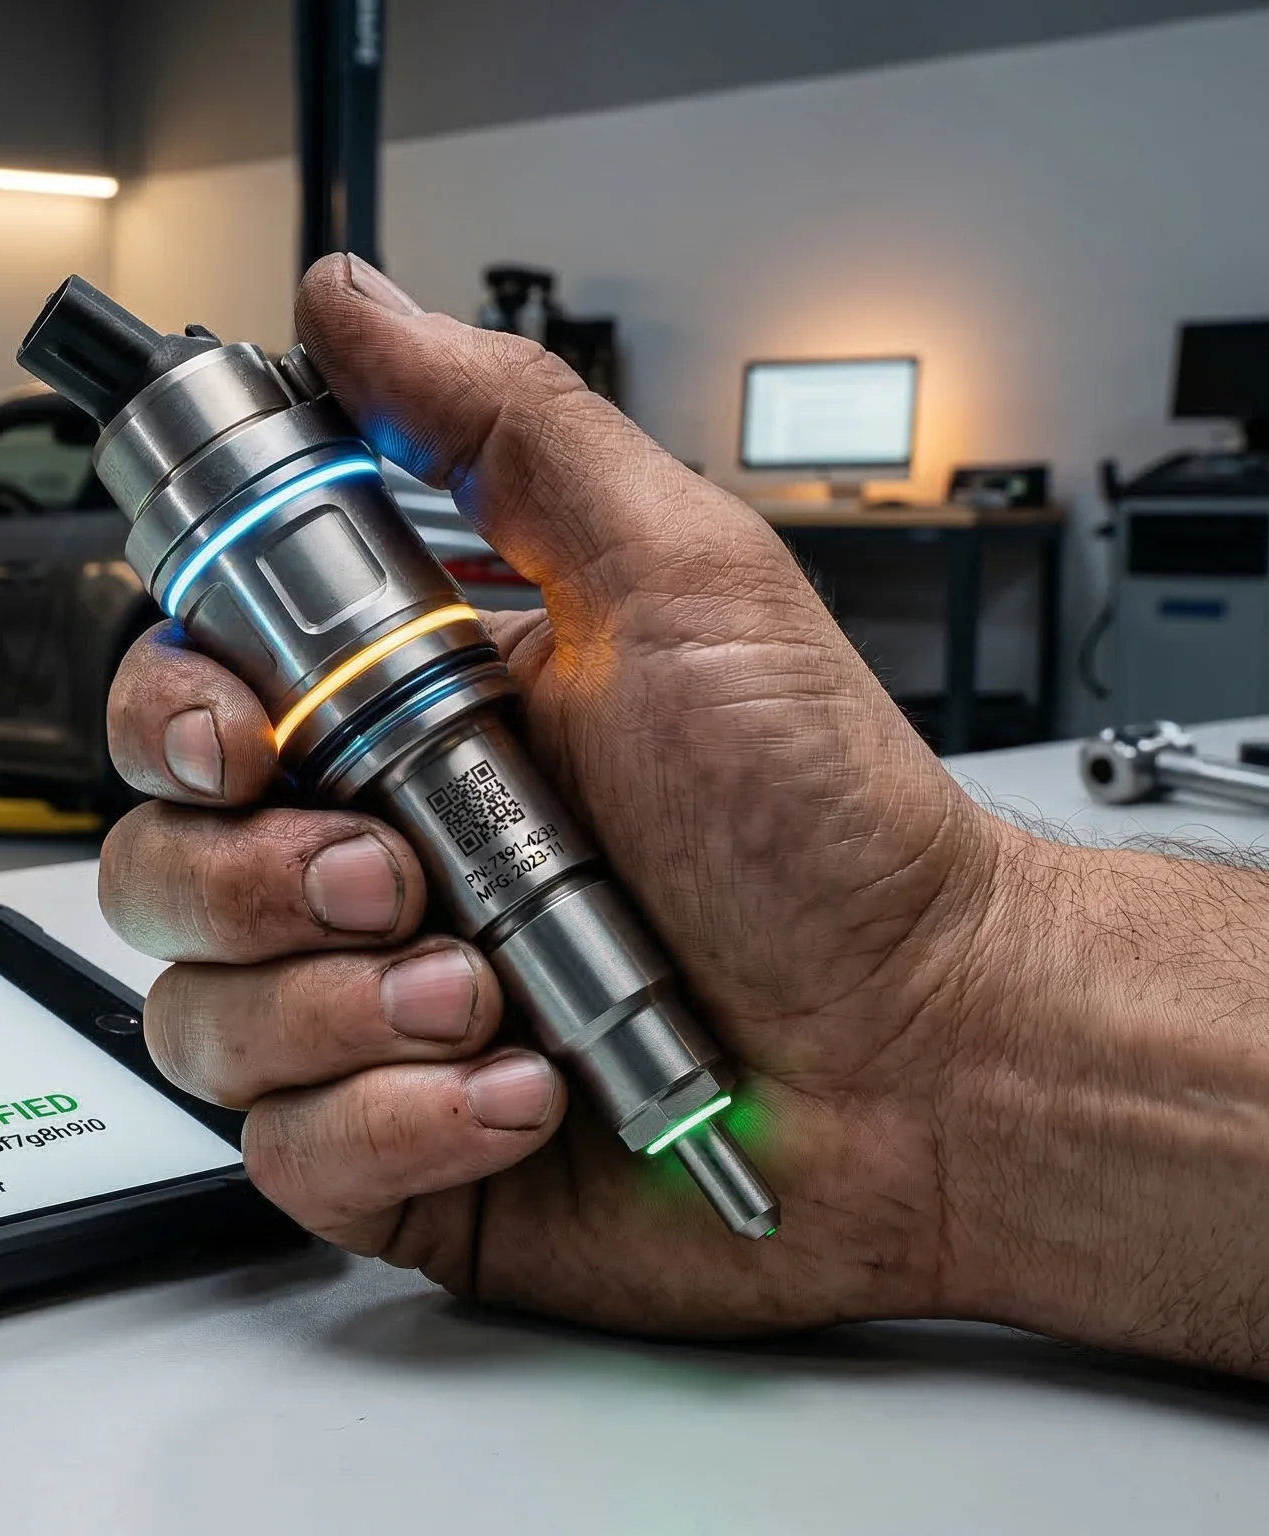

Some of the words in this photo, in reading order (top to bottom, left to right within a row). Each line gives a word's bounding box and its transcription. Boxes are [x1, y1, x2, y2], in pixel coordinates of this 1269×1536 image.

[465, 865, 492, 888] PN:
[476, 874, 513, 904] MFG:
[511, 841, 564, 879] 2023-11
